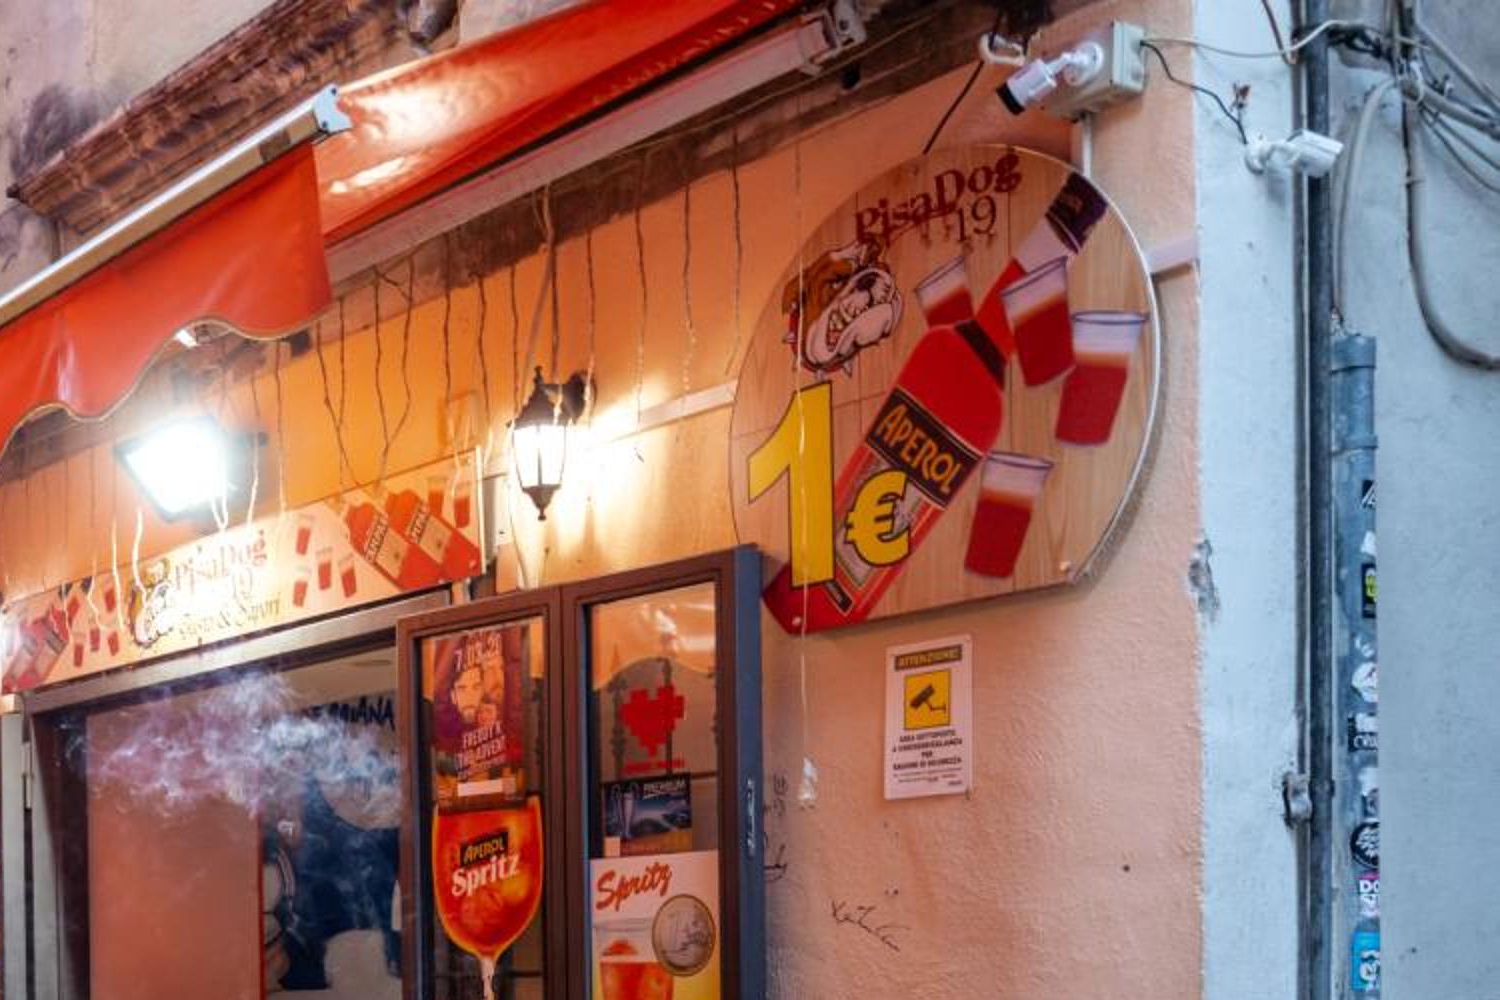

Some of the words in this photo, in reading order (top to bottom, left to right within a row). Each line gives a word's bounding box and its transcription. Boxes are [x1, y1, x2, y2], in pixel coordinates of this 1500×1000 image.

[747, 380, 835, 588] 1
[843, 467, 911, 568] €
[876, 403, 962, 495] APEROL
[451, 853, 520, 897] Spritz
[596, 861, 673, 912] Spritz
